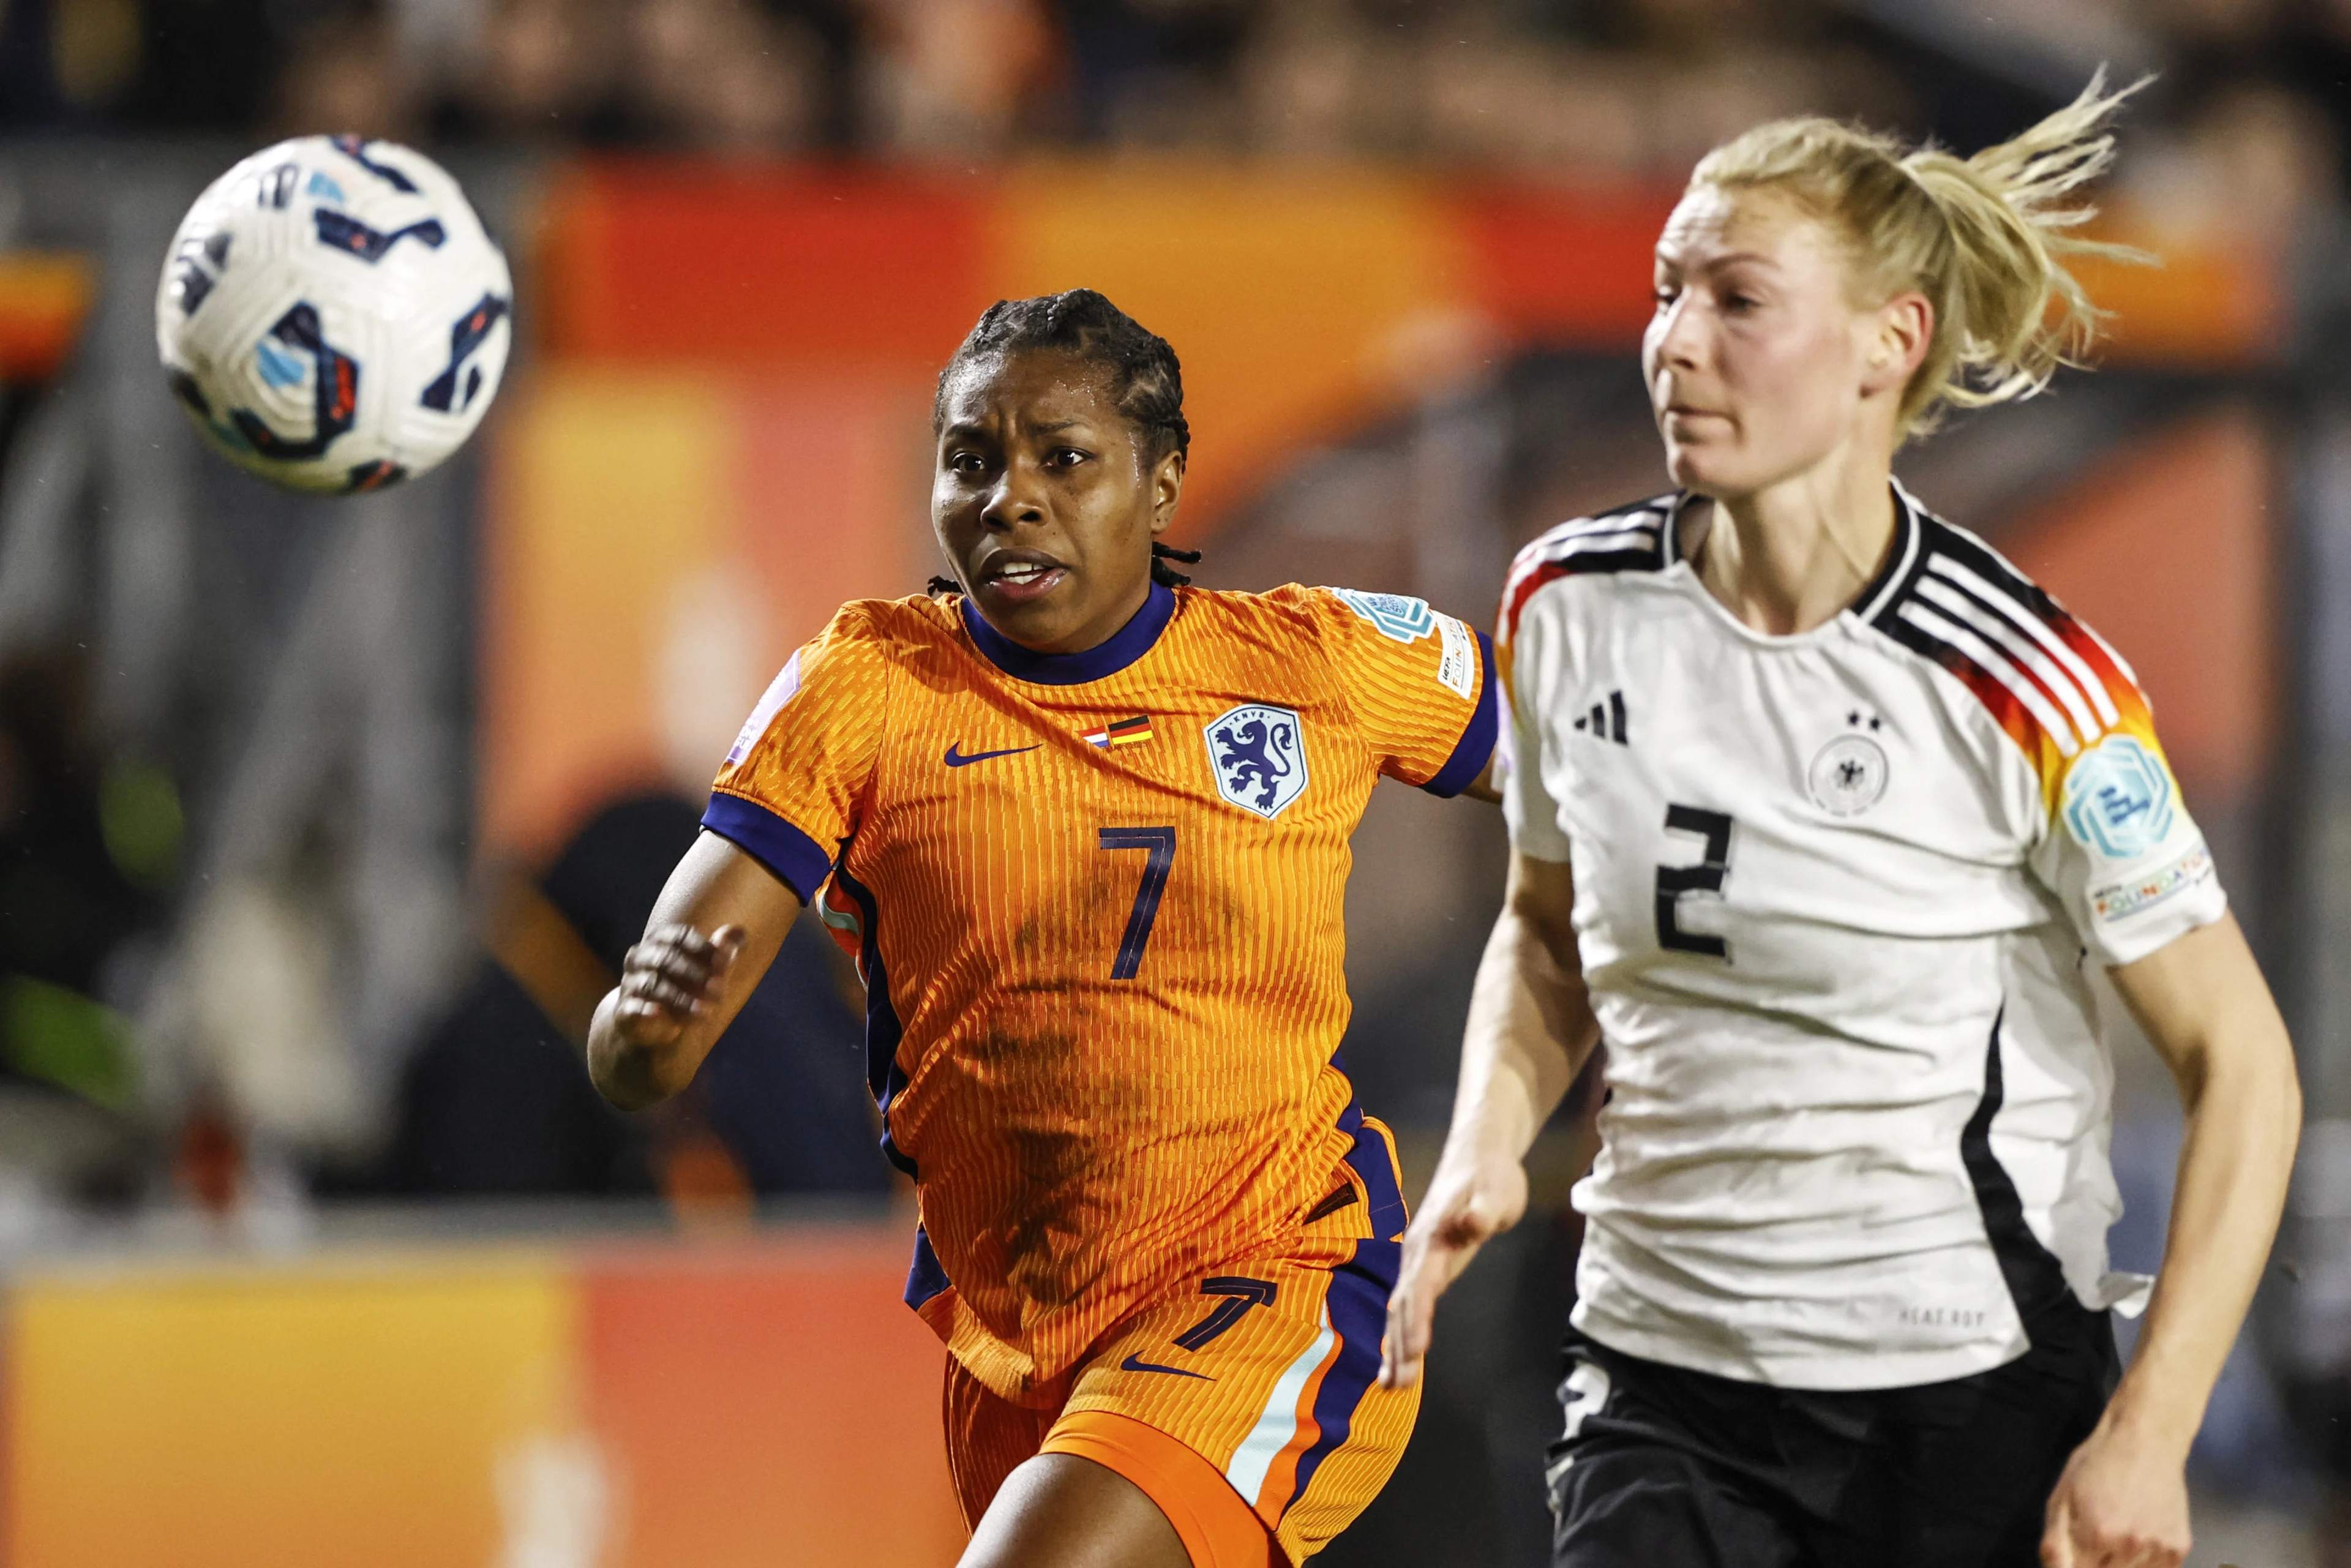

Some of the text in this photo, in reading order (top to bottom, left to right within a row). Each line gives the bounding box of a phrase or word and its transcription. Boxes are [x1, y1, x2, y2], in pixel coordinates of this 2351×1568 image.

[1442, 656, 1451, 681] UEFA
[1446, 618, 1462, 687] FOUNDATIO
[1233, 711, 1264, 722] KNVB
[1098, 826, 1176, 980] 7
[1656, 803, 1733, 960] 2
[1172, 1276, 1278, 1352] 7
